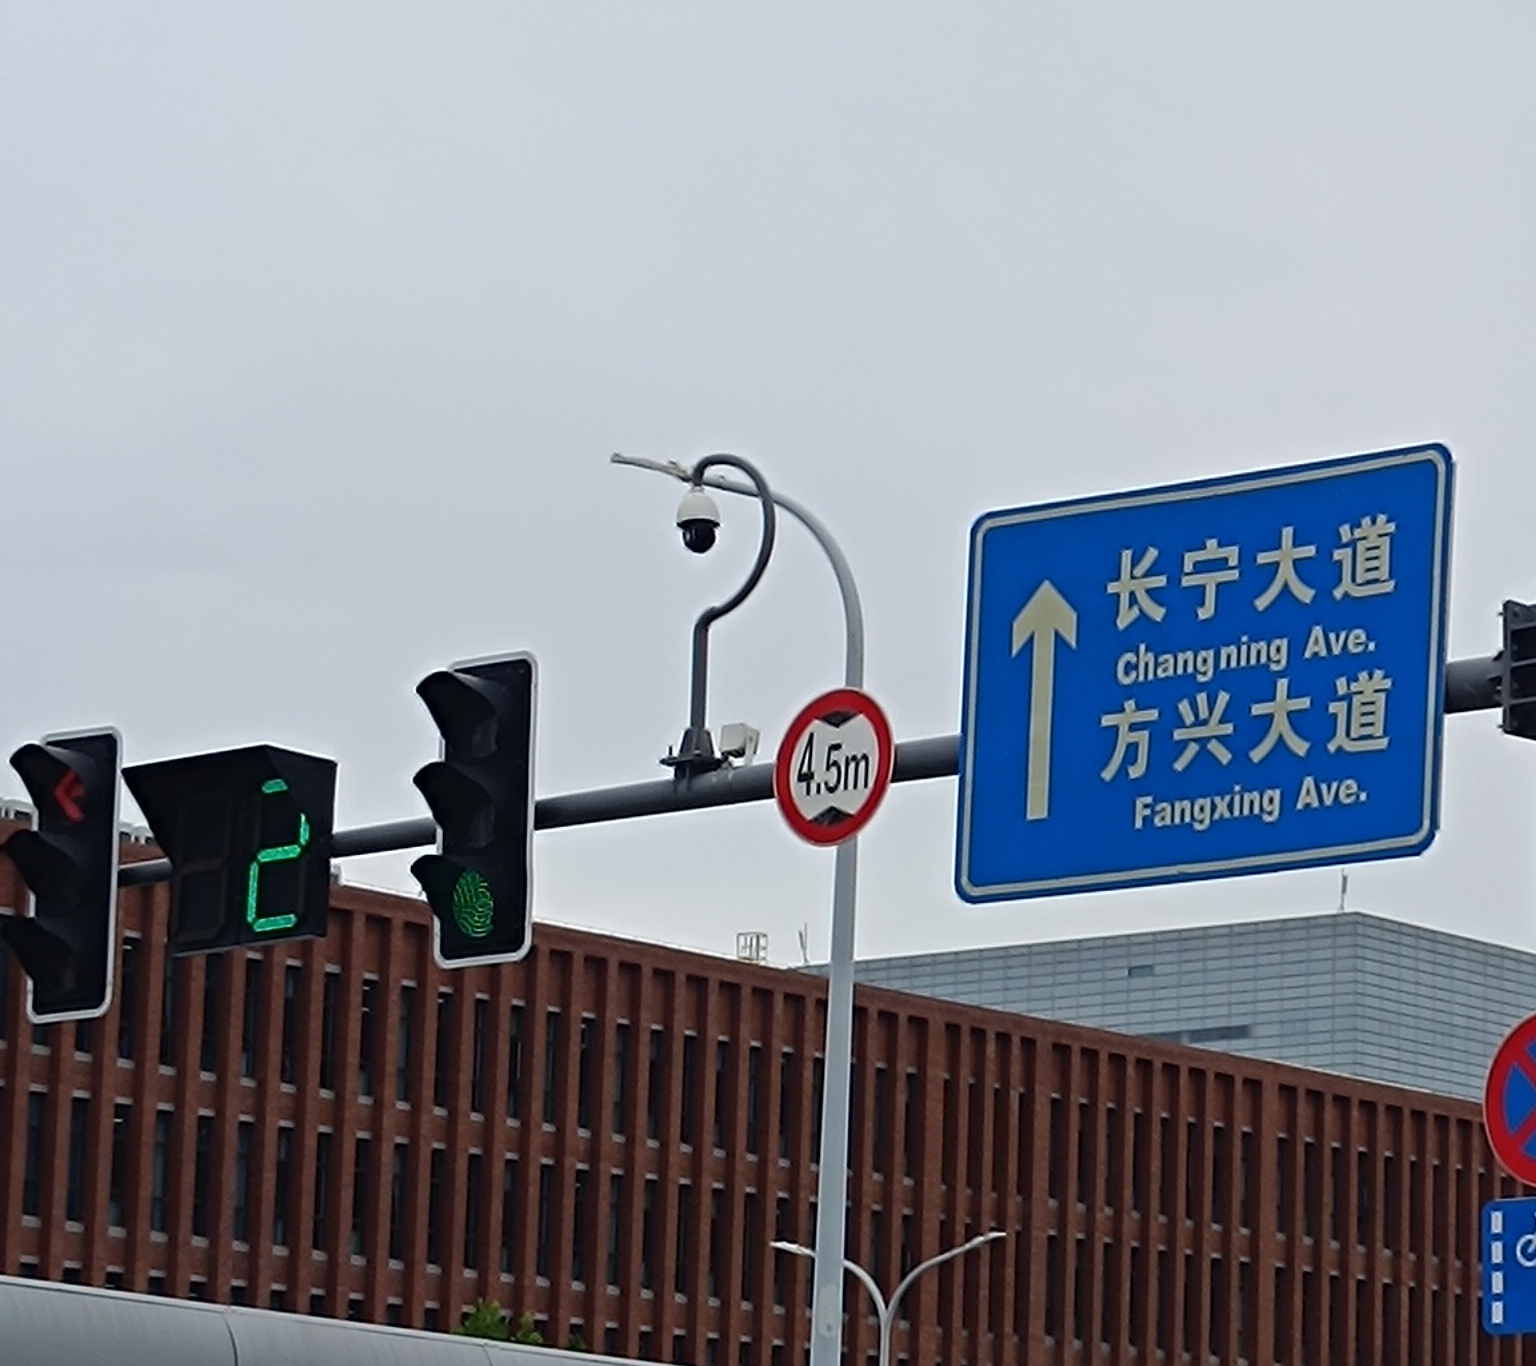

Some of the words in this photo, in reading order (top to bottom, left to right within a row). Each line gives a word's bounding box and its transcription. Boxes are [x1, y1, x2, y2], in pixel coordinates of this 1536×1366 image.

[1107, 513, 1396, 630] 长宁大道
[1304, 625, 1376, 659] Ave.
[1101, 669, 1392, 781] 方兴大道
[797, 732, 870, 796] 4.5m
[1135, 785, 1281, 831] Fangxing
[1296, 776, 1368, 810] Ave.
